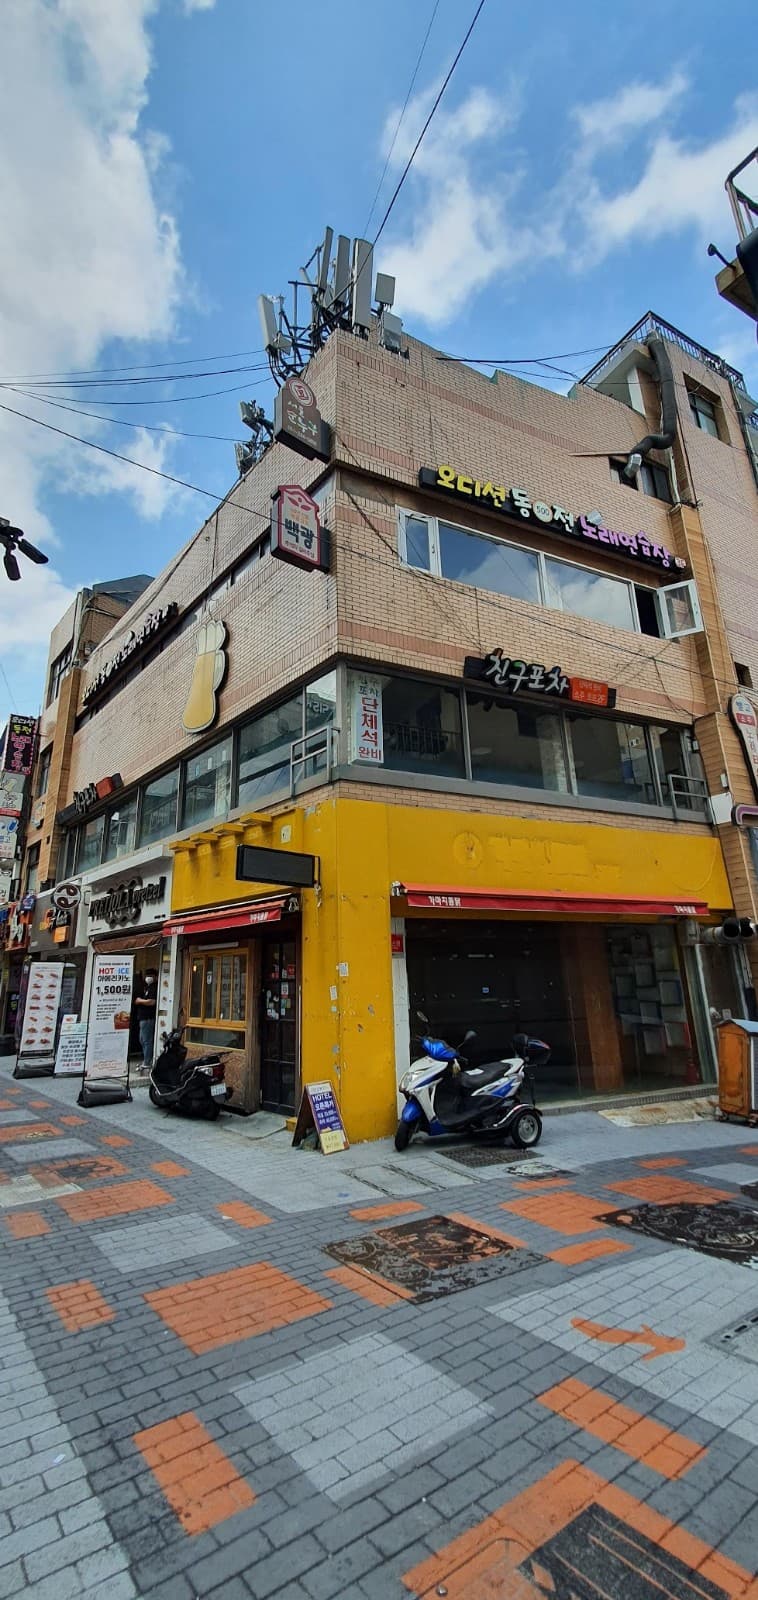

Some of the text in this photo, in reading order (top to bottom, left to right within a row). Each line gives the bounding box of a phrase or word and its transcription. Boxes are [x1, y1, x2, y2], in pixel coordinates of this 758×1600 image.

[437, 465, 505, 508] 오디션
[579, 514, 670, 568] 노래연습장
[284, 518, 314, 550] 백광
[486, 655, 570, 693] 친구포차
[361, 697, 379, 747] 단체석
[358, 746, 382, 760] 완비
[95, 985, 131, 997] 1,500원
[312, 1092, 333, 1103] HOTEL
